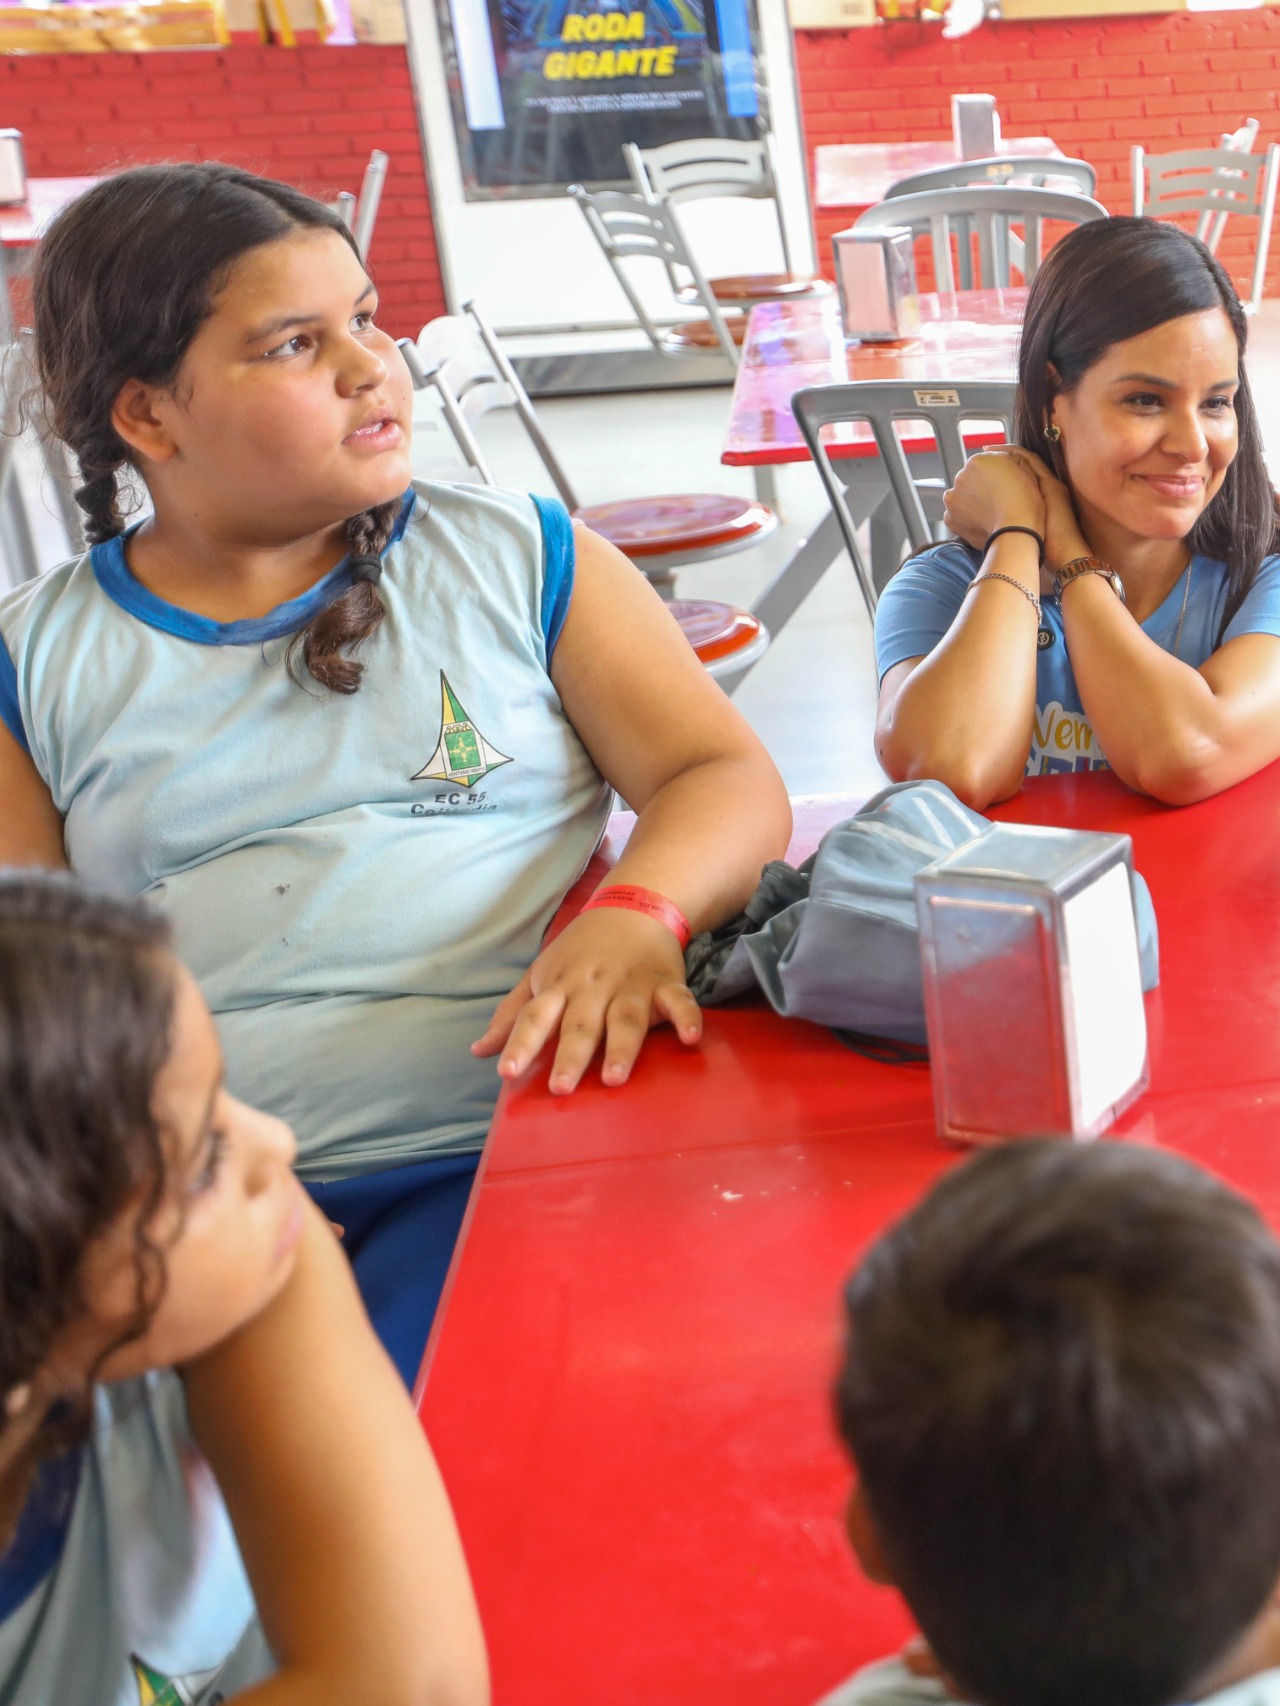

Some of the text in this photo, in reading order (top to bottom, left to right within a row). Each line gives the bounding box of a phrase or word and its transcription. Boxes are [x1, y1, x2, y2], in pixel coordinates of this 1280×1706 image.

[561, 11, 645, 43] RODA
[543, 45, 678, 80] GIGANTE
[435, 792, 487, 805] EC 55
